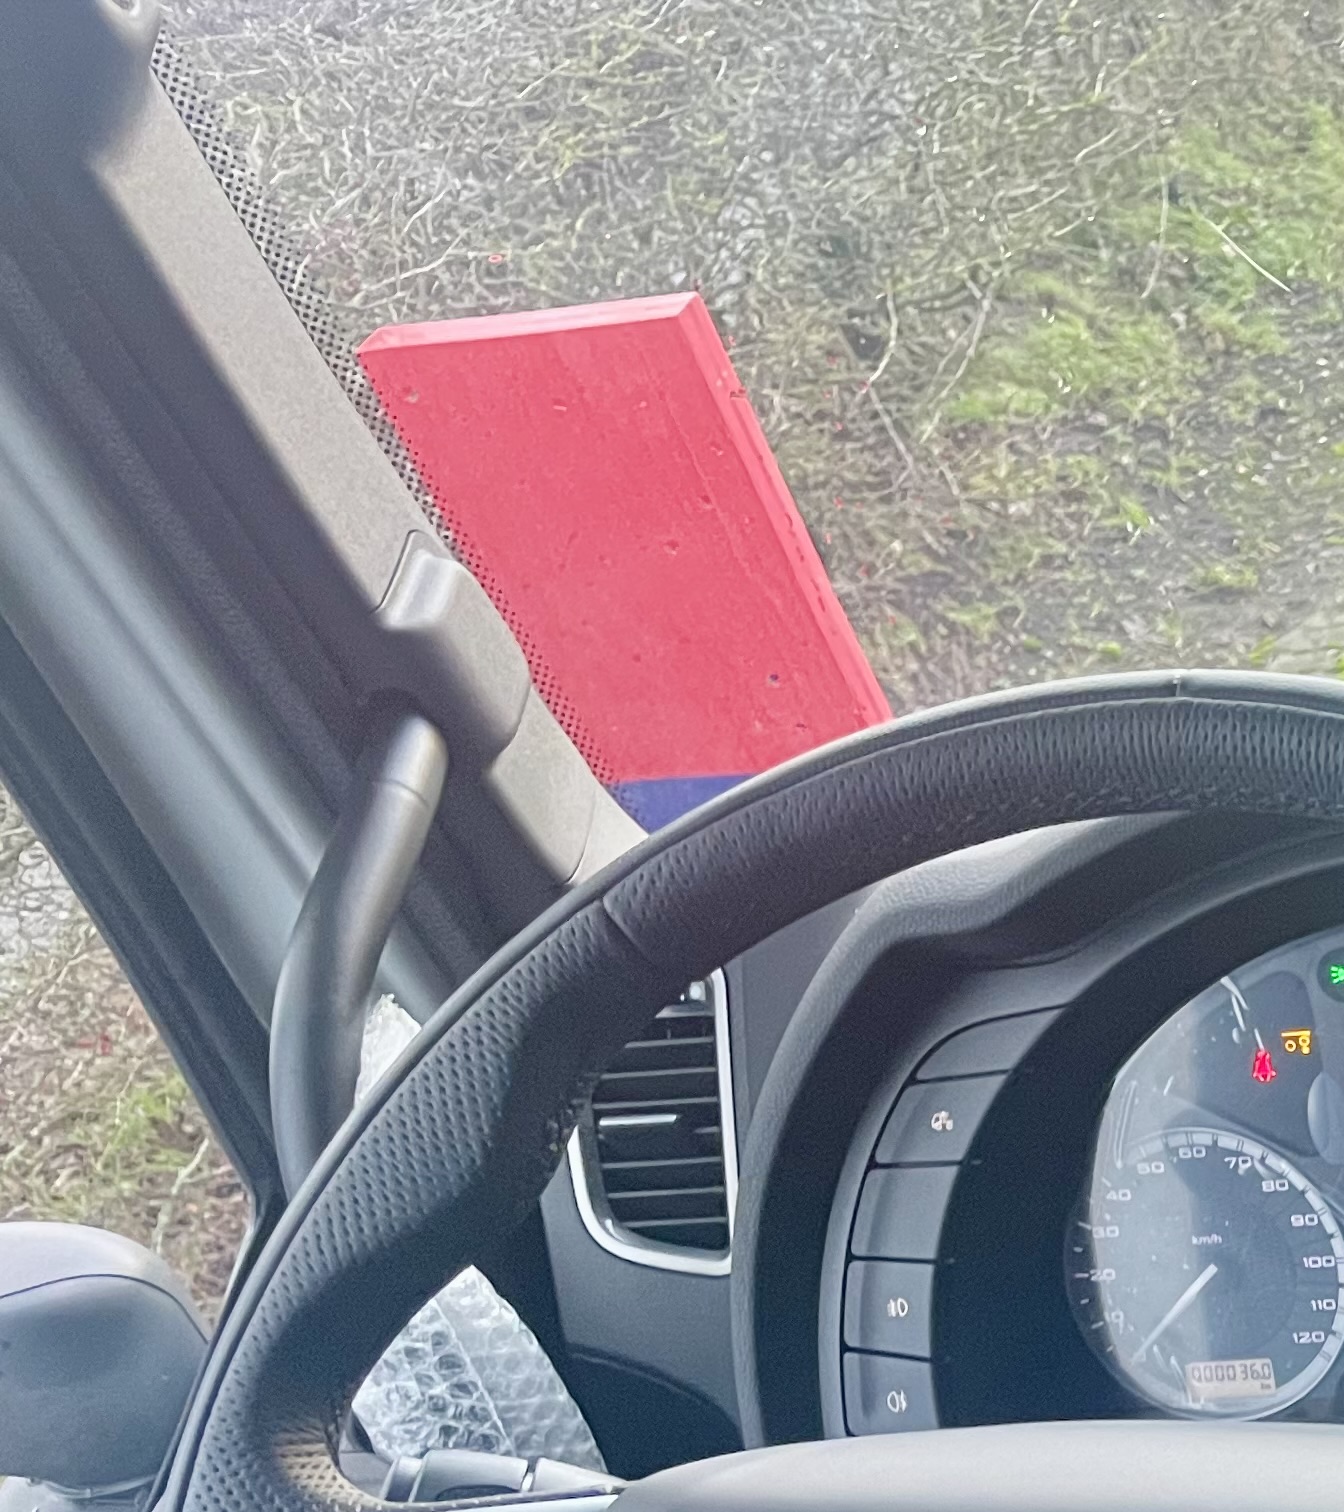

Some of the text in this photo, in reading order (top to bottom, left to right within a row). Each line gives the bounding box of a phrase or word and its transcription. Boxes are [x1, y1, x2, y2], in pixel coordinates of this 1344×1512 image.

[1178, 1147, 1206, 1159] 60
[1224, 1156, 1253, 1169] 70
[1262, 1179, 1289, 1192] 80
[1106, 1189, 1131, 1201] 40
[1290, 1214, 1318, 1227] 90
[1191, 1234, 1222, 1246] km/h
[1302, 1255, 1335, 1268] 100
[1090, 1268, 1116, 1281] 20
[1310, 1299, 1336, 1311] 110
[1292, 1331, 1325, 1345] 120
